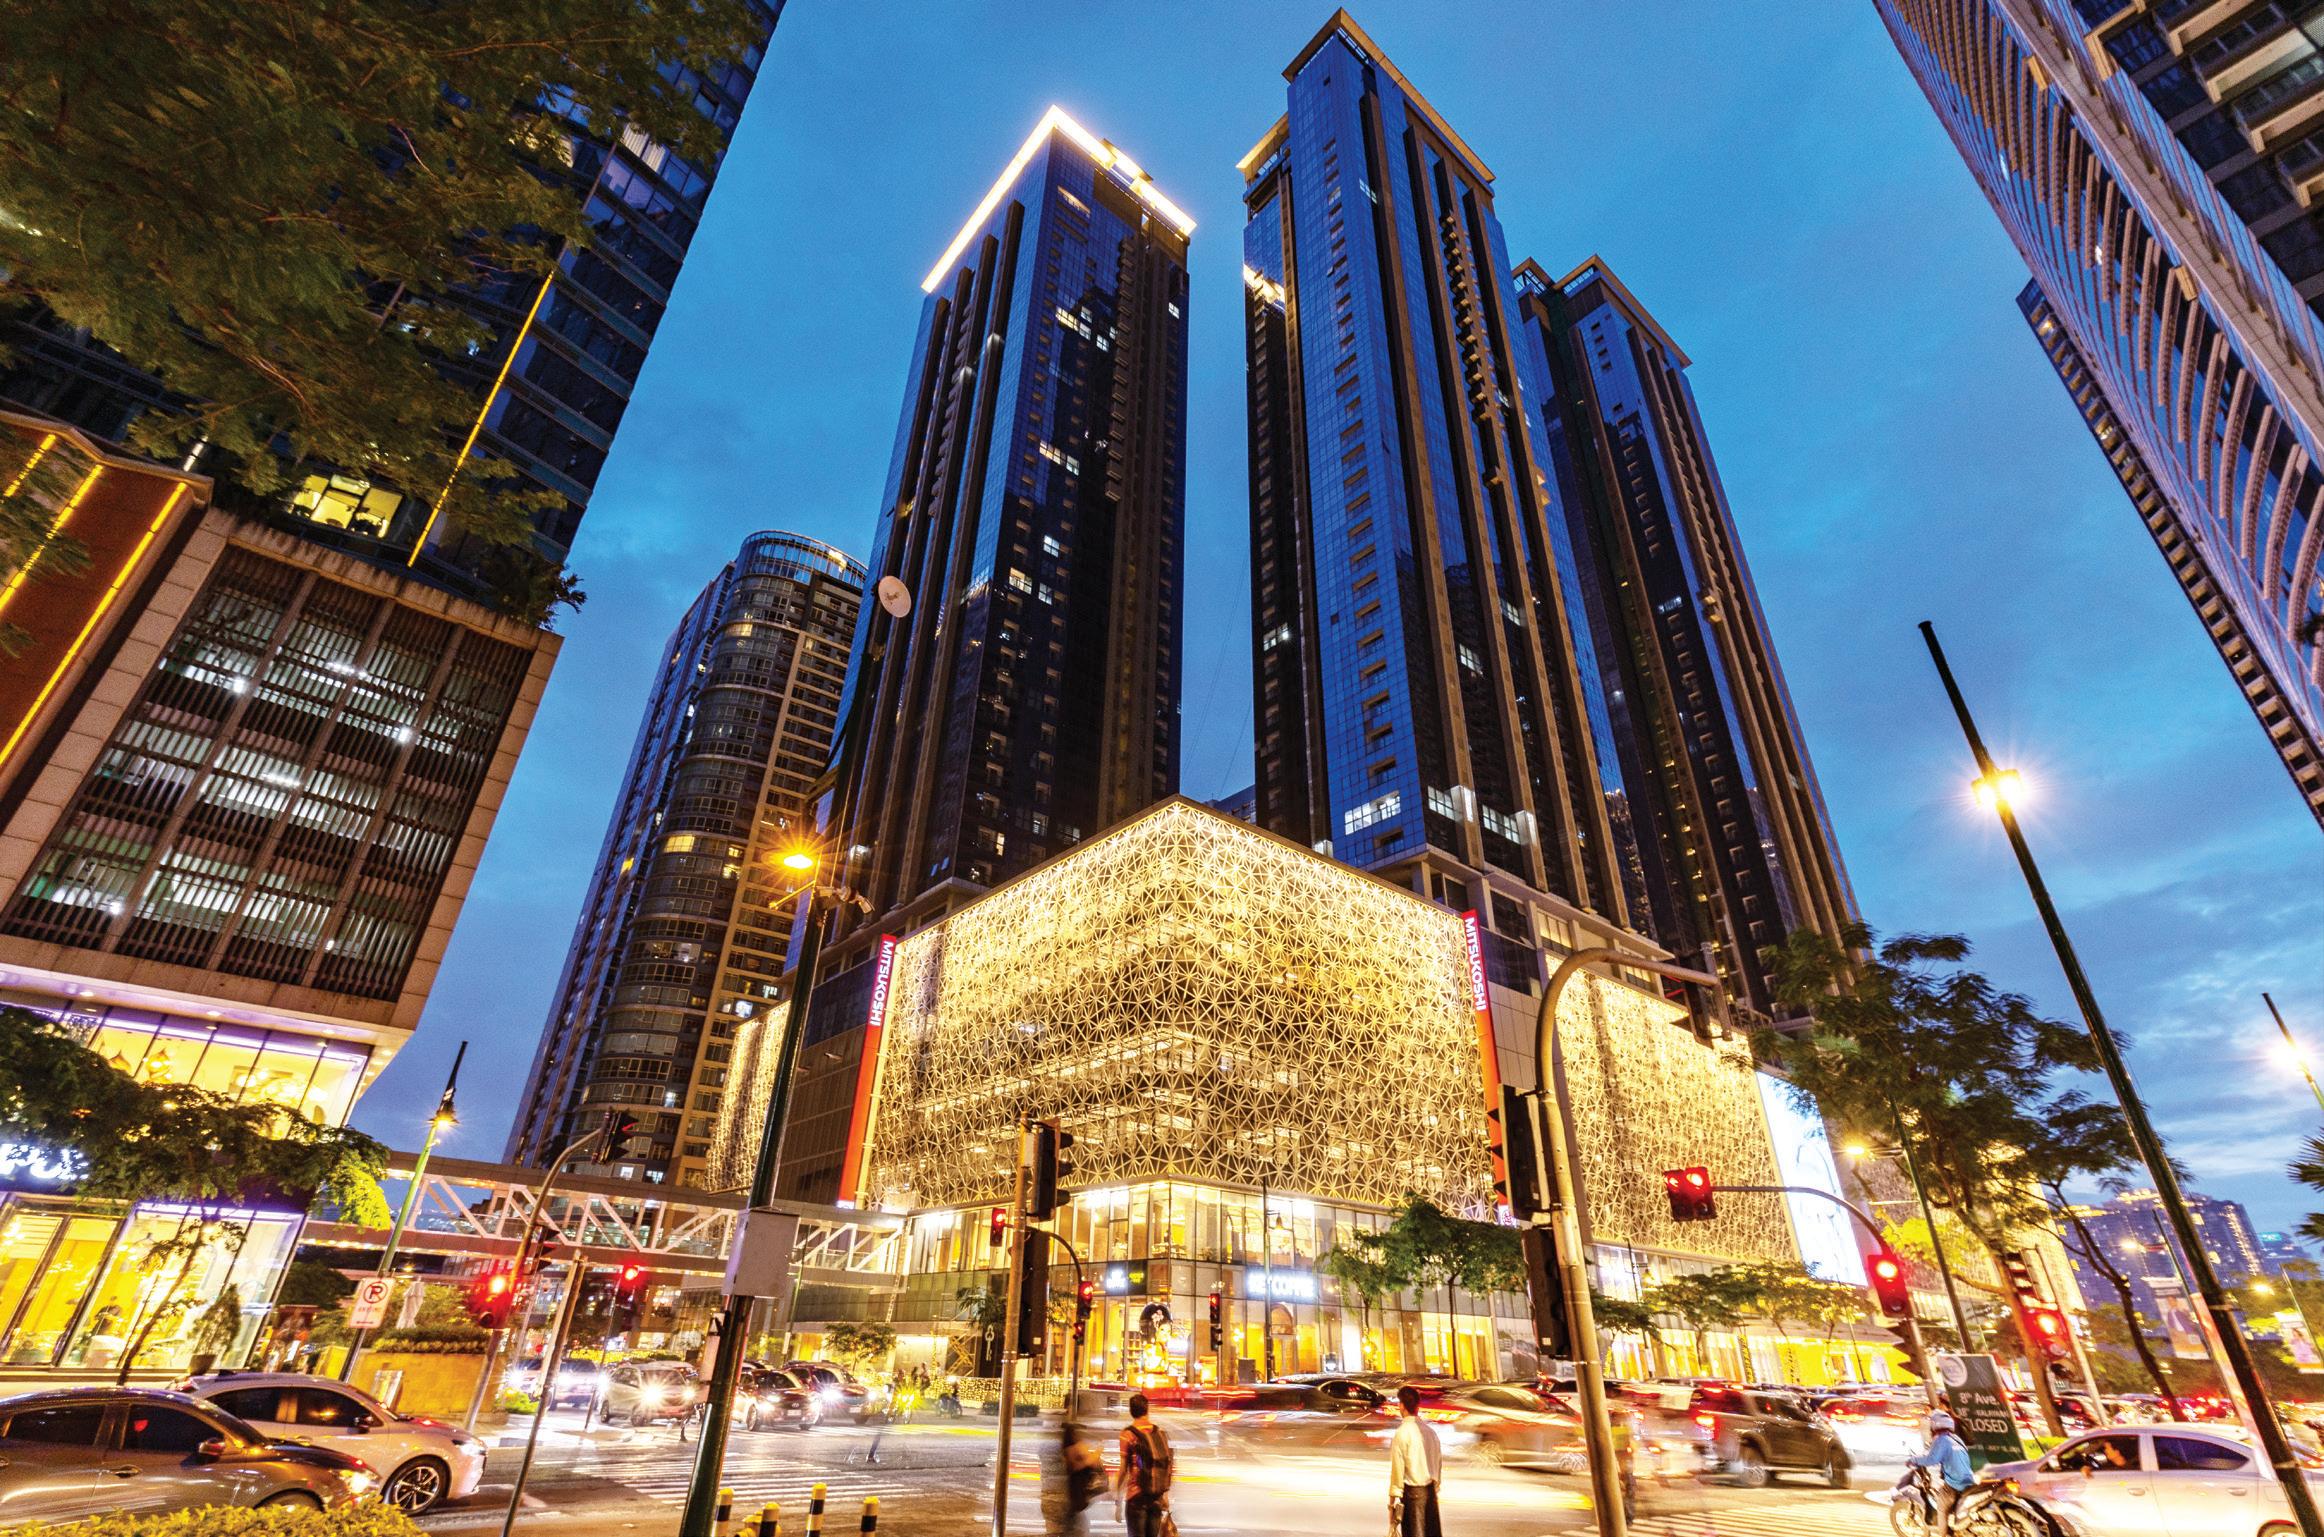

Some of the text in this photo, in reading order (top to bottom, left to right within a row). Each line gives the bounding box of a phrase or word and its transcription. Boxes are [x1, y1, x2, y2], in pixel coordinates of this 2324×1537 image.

[869, 940, 894, 1026] MITSUKOSHI
[1465, 917, 1487, 1011] MITSUKOSHI
[1974, 1392, 2000, 1405] Ave.
